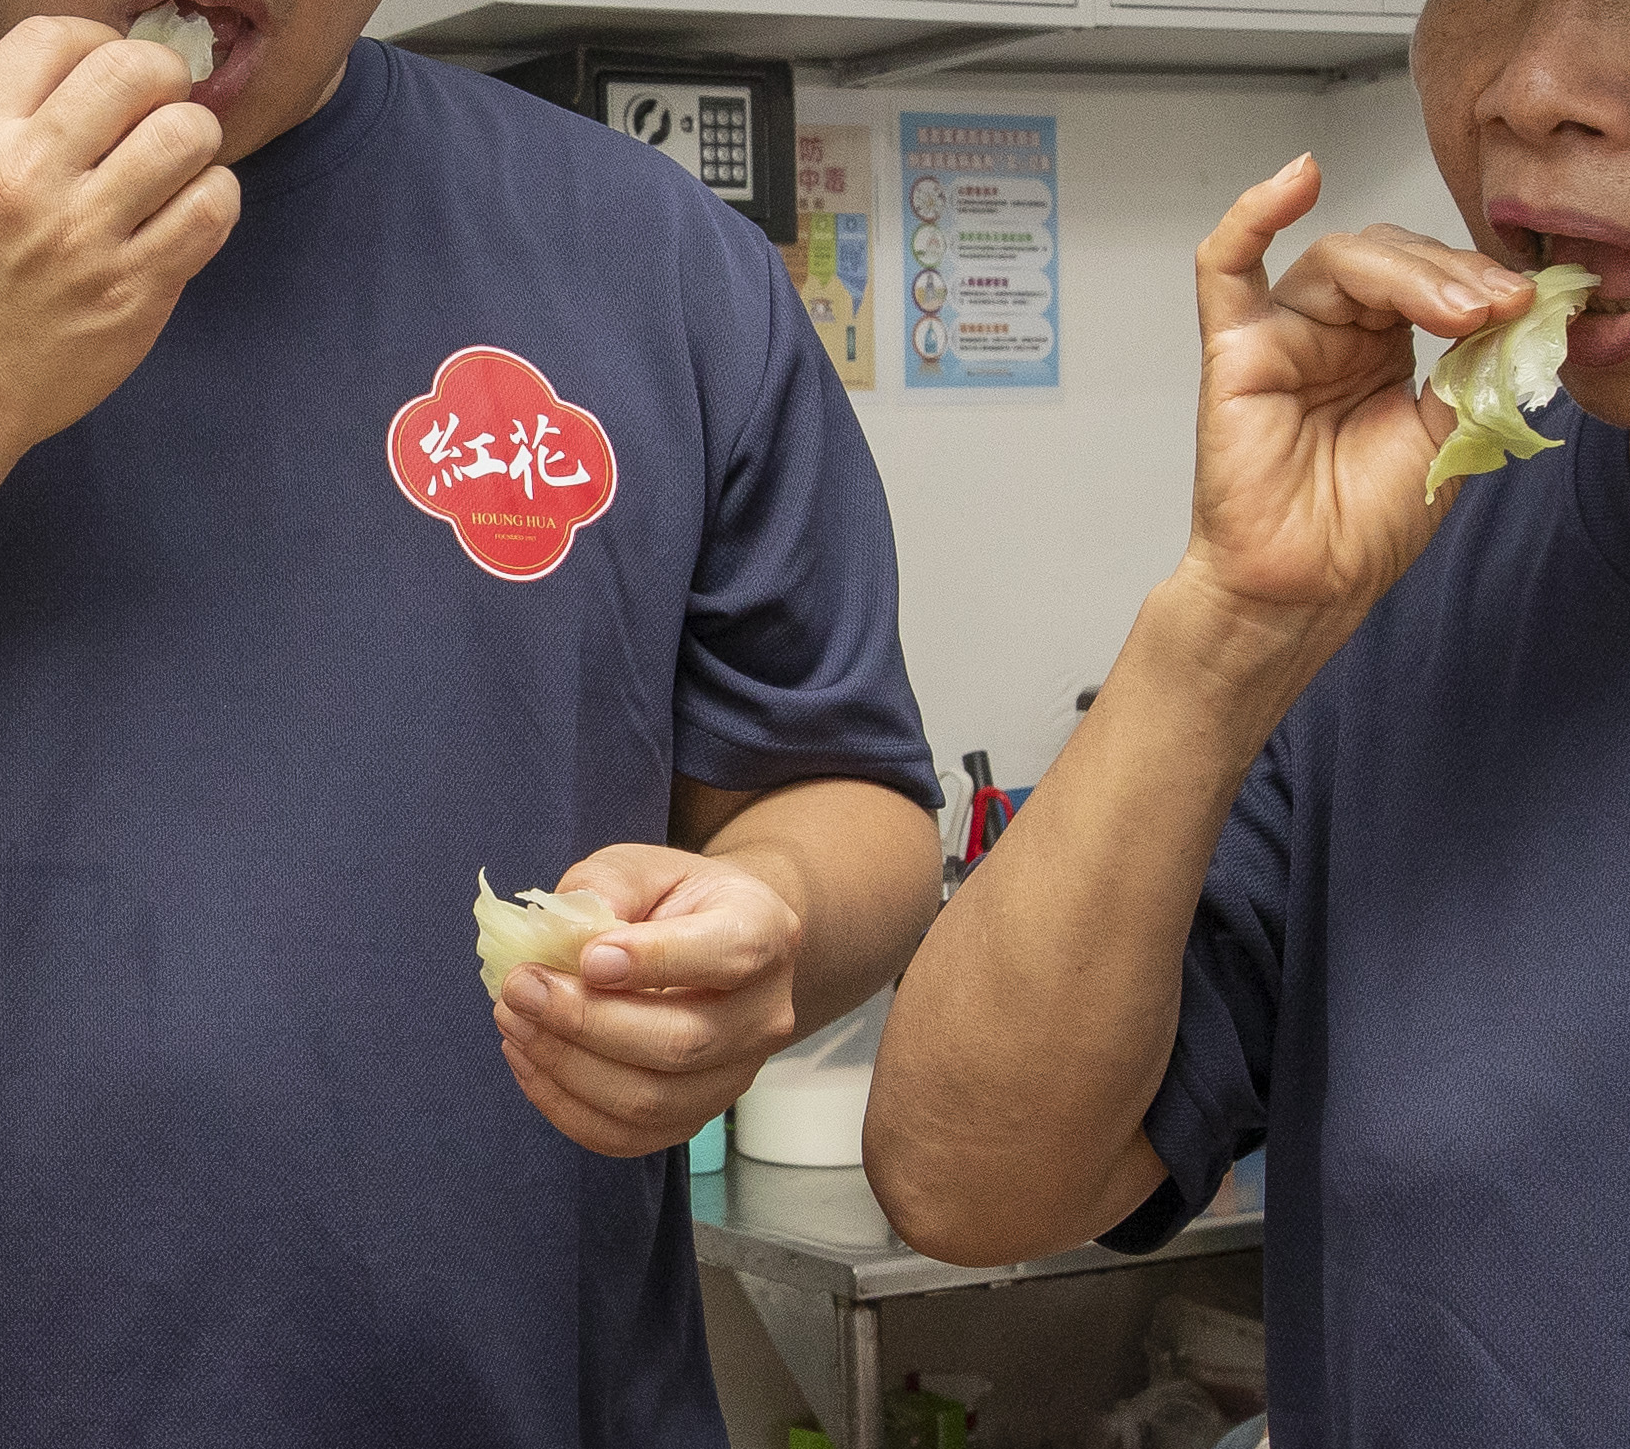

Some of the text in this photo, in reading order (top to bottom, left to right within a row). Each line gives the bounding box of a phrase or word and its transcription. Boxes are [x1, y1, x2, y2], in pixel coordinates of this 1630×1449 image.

[419, 412, 591, 500] 紅花
[471, 512, 556, 529] HOUNG HUA
